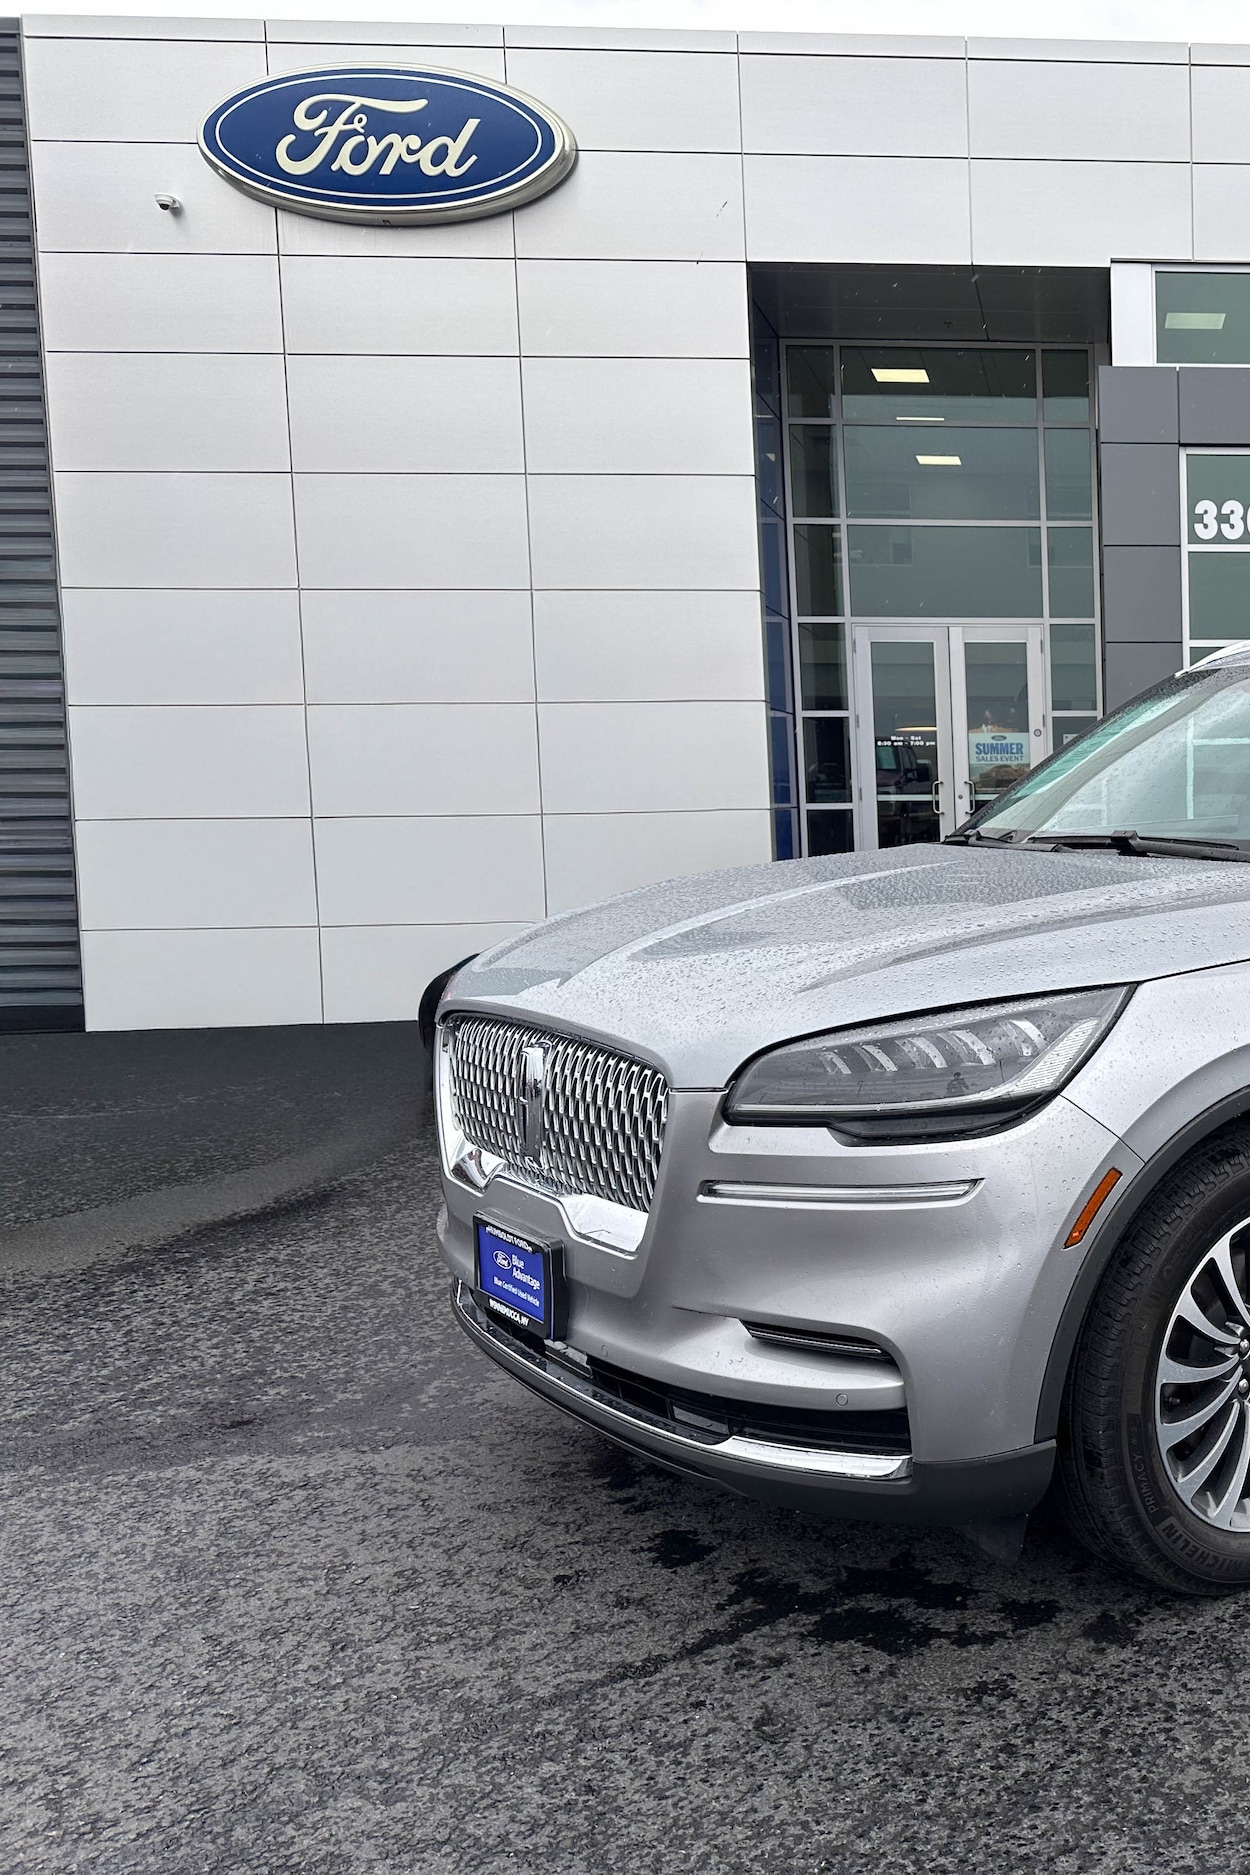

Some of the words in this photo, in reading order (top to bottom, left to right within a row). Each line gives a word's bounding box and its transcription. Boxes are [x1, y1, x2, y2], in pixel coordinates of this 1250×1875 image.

[275, 93, 481, 178] Ford
[975, 742, 1024, 755] SUMMER
[511, 1254, 525, 1269] Blue
[512, 1267, 541, 1290] Advantage
[517, 1288, 528, 1300] Used
[1131, 1452, 1159, 1514] PRIMACY
[1162, 1522, 1243, 1574] MICHELIN
